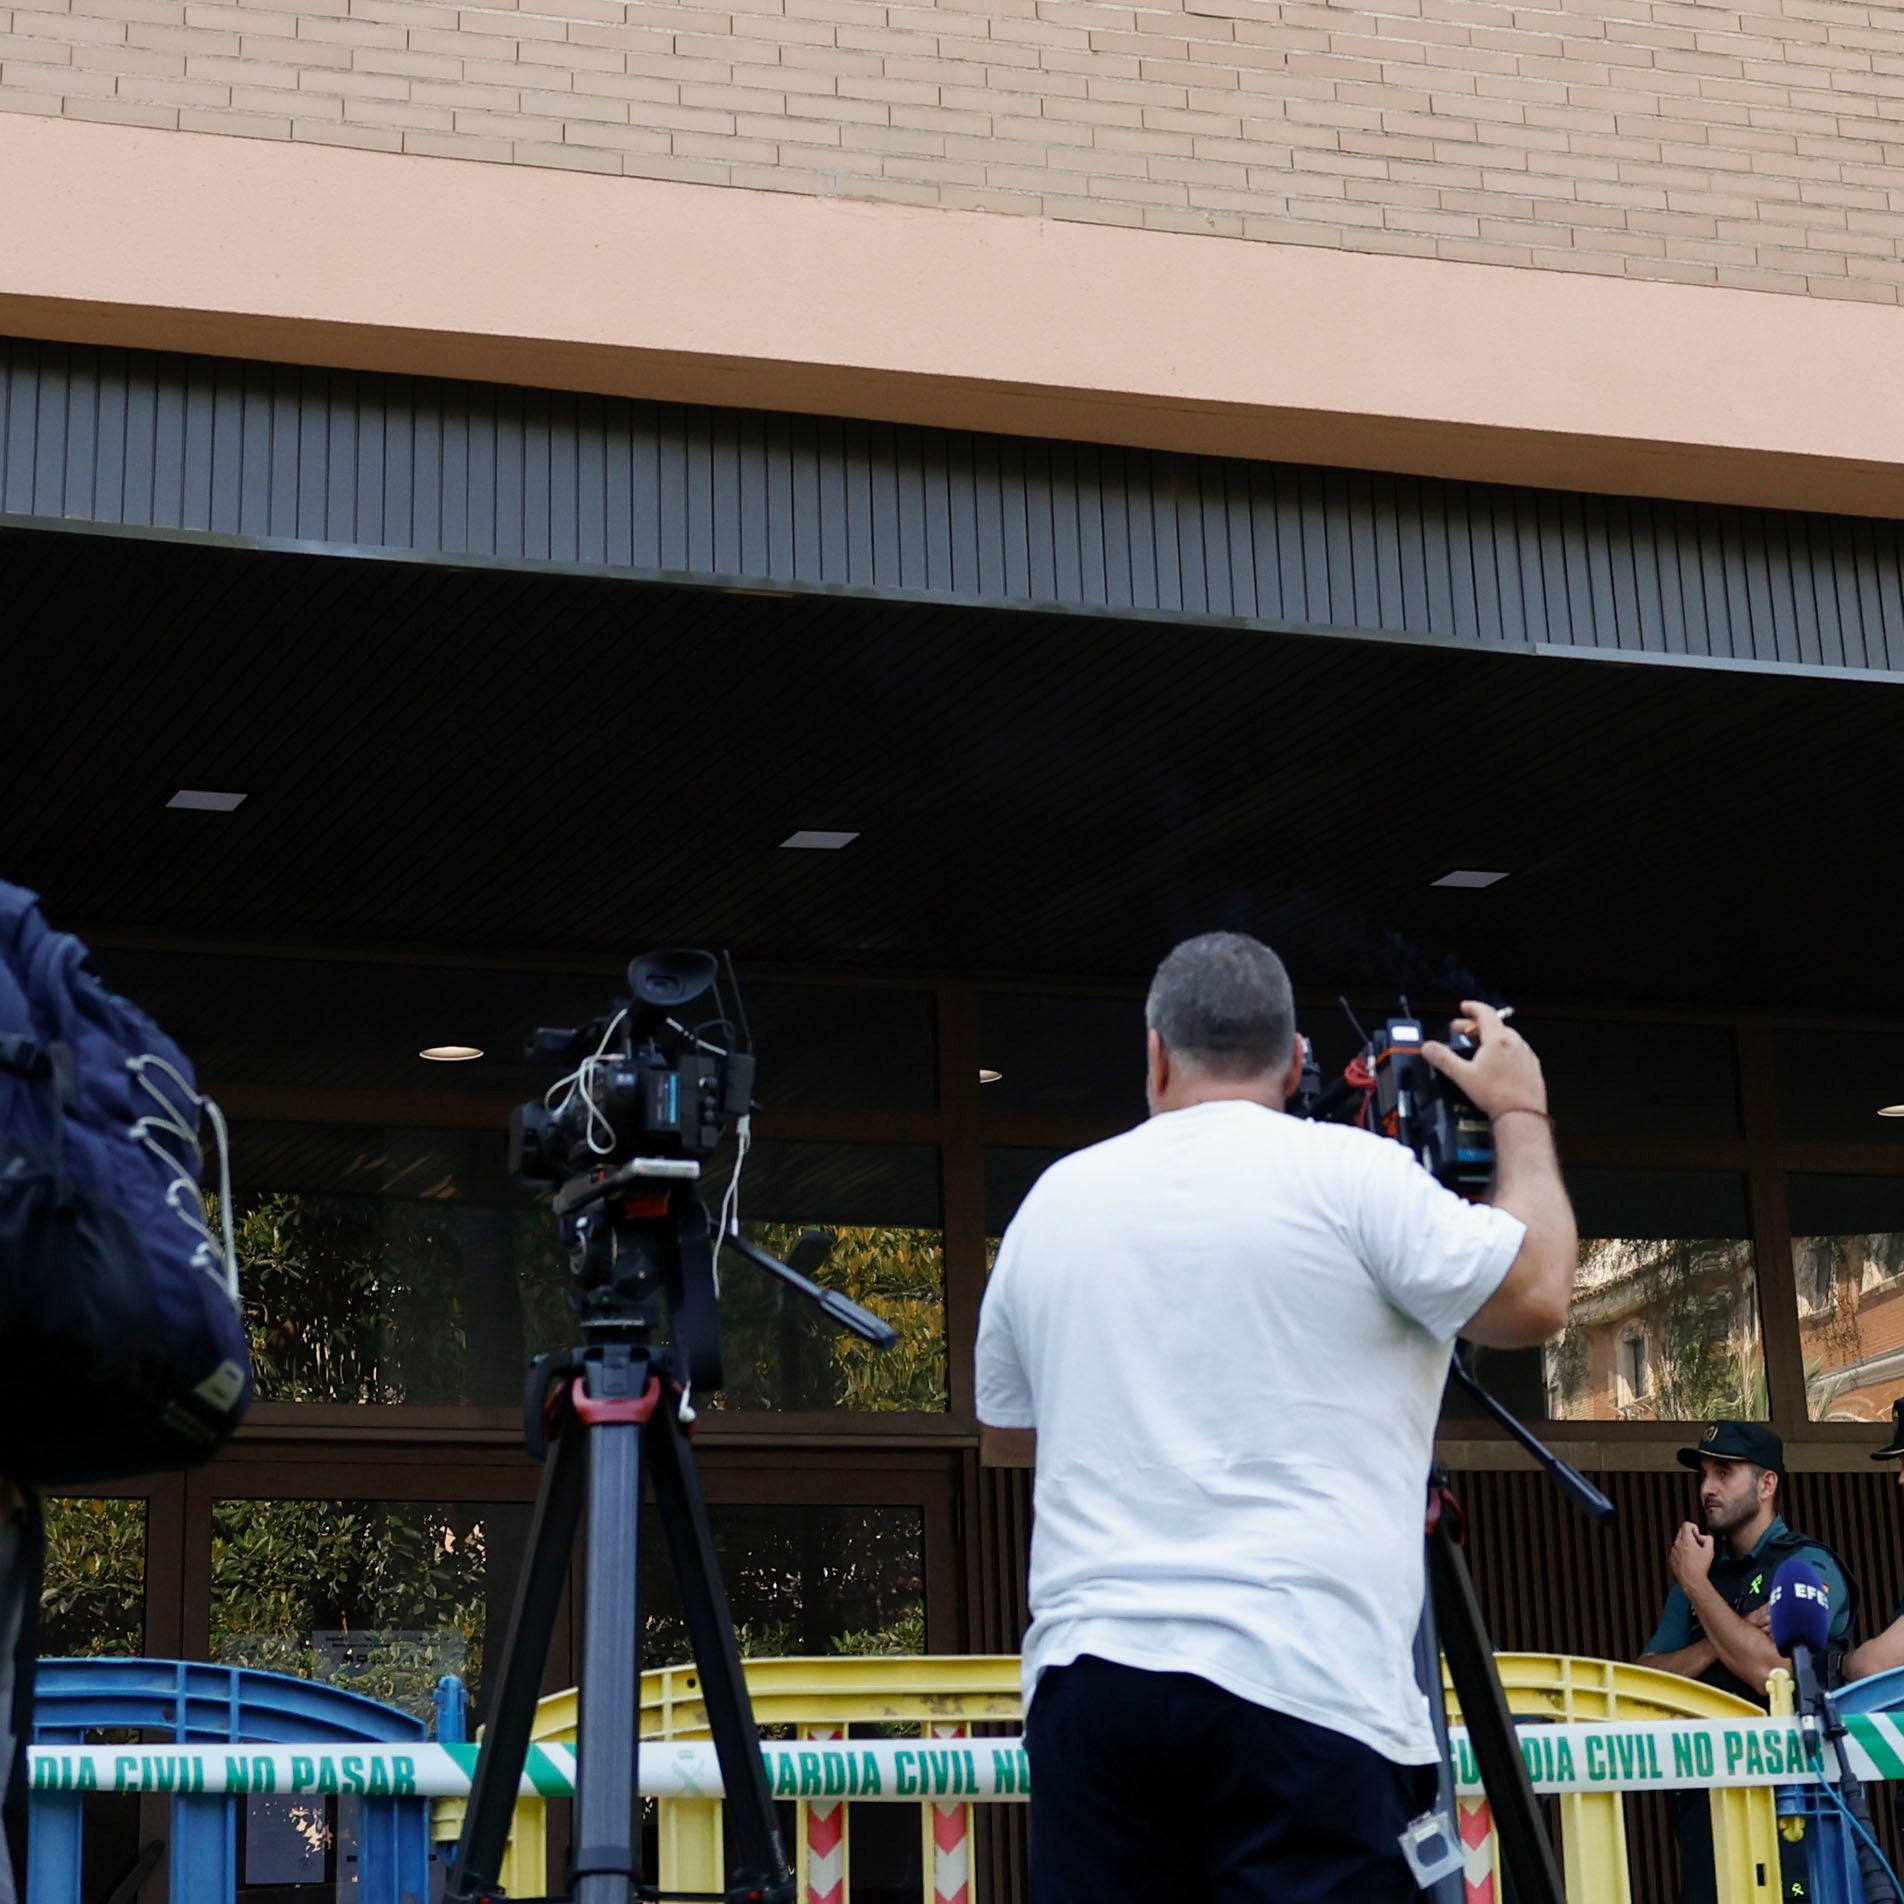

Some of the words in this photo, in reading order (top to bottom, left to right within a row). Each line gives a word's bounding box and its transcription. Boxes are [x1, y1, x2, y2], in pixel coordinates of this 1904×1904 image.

[226, 1756, 276, 1794] NO
[291, 1755, 416, 1796] PASAR
[763, 1751, 883, 1796] ARDIA
[895, 1750, 980, 1795] CIVIL
[1586, 1733, 1663, 1780] CIVIL
[1673, 1732, 1714, 1778] NO
